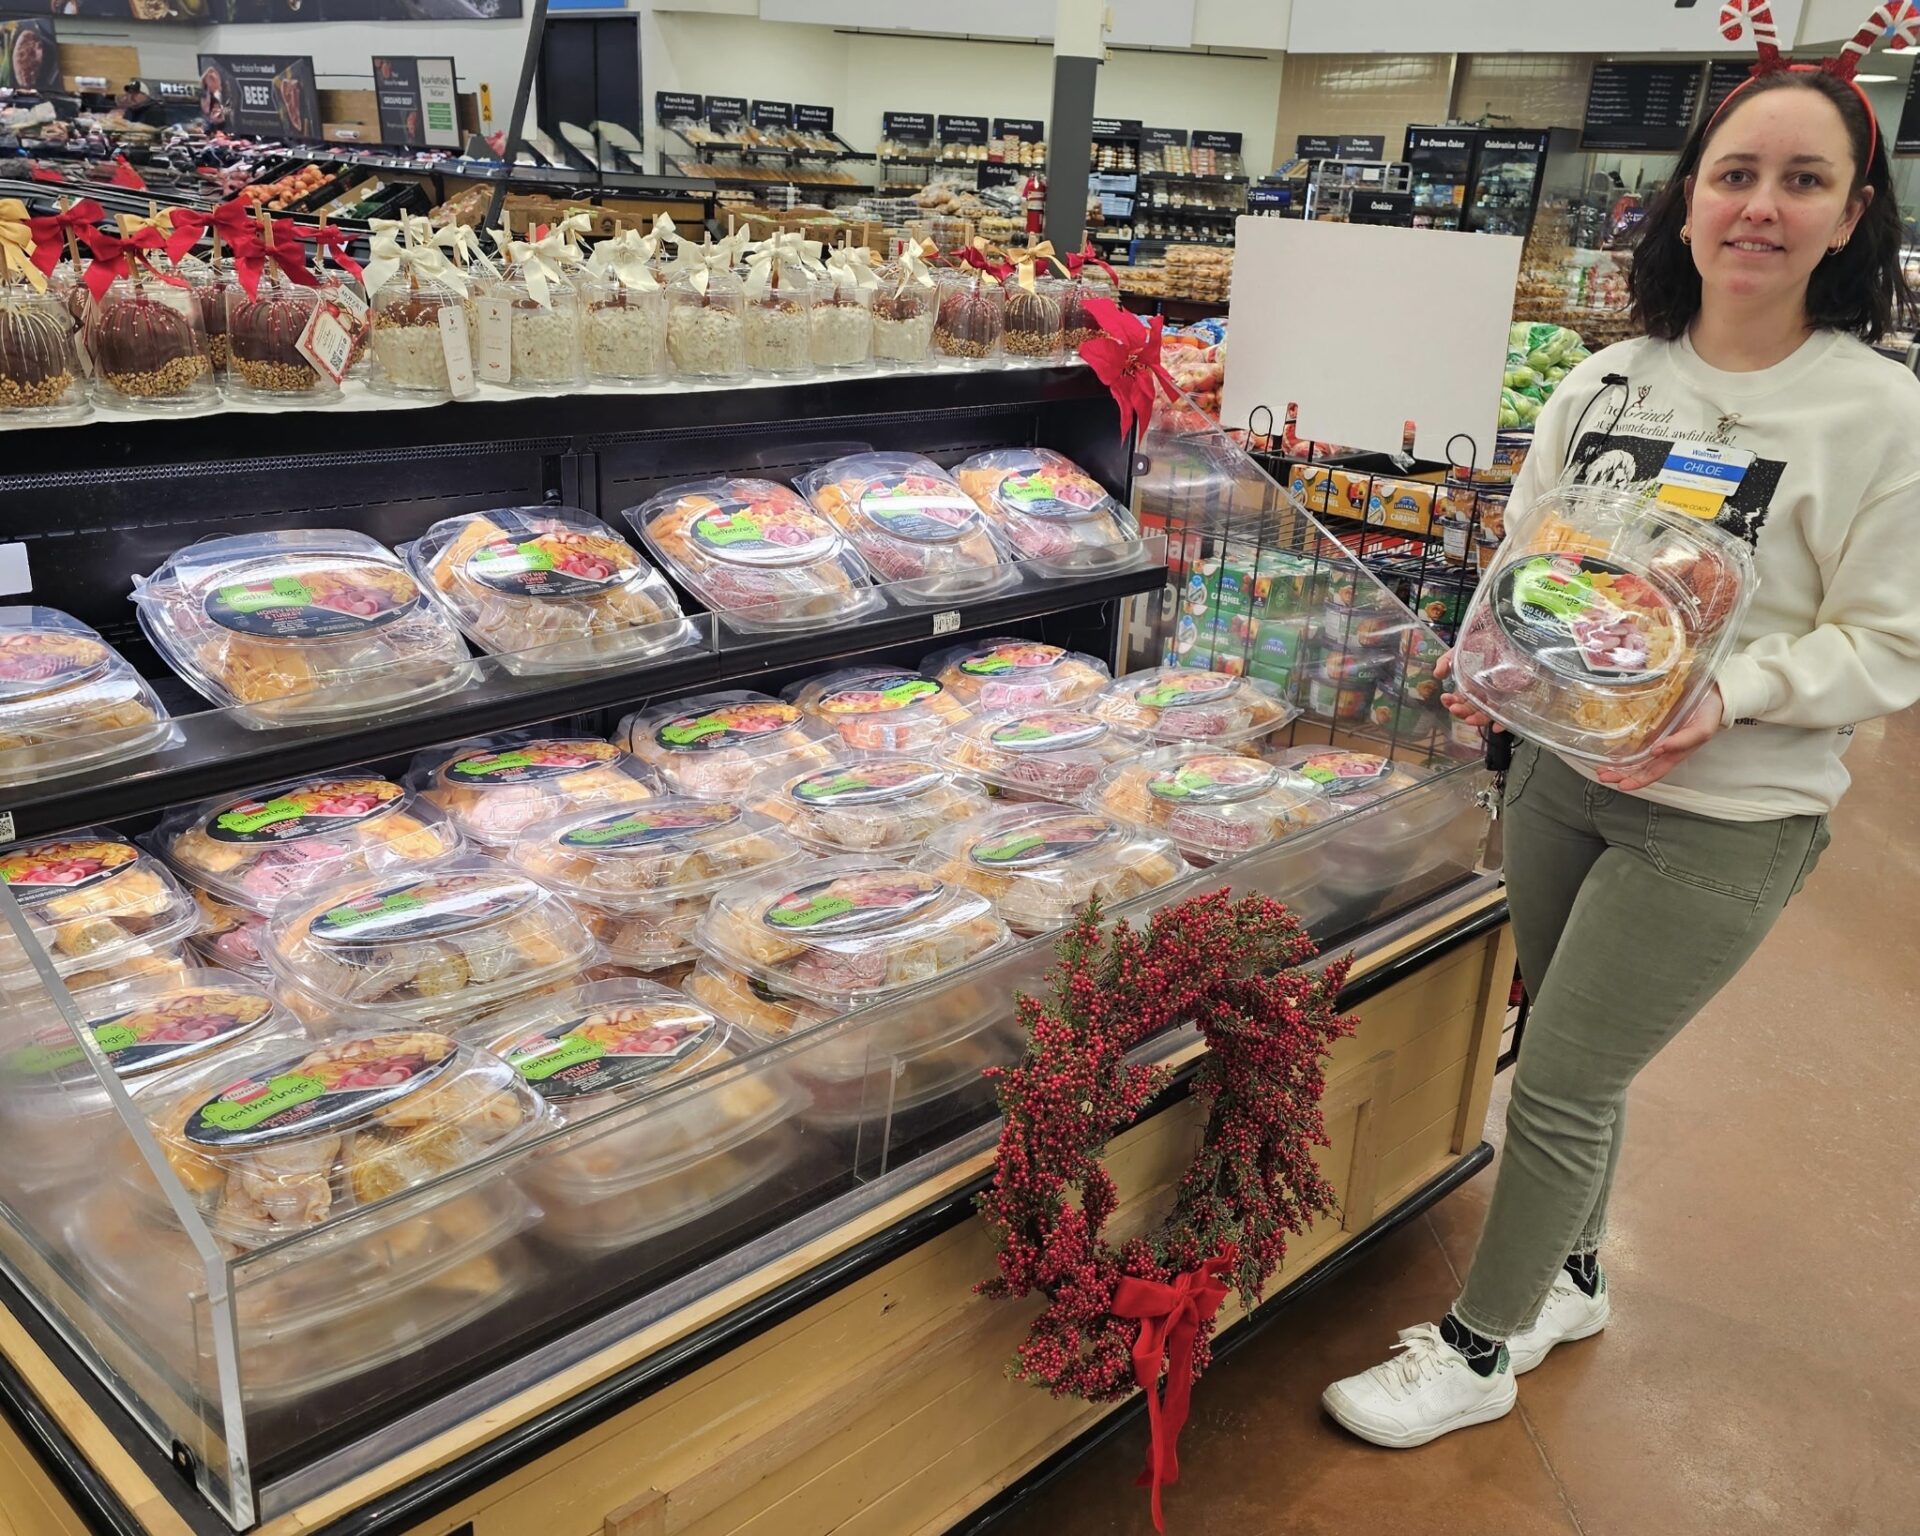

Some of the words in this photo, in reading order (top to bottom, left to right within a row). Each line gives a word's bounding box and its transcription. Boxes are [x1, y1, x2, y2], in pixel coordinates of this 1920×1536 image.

[244, 85, 270, 105] BEEF
[384, 96, 401, 105] GROUND
[402, 97, 412, 105] BEEF
[665, 96, 680, 104] French
[681, 97, 694, 105] Bread
[713, 100, 728, 108] French
[1420, 138, 1429, 148] Ice
[1429, 139, 1447, 148] Cream
[1448, 139, 1465, 148] Cakes
[1485, 140, 1516, 149] Celebration
[1517, 141, 1535, 150] Cakes
[987, 166, 999, 174] Garlic
[1371, 201, 1393, 211] Cookies
[1624, 406, 1674, 424] Grinch
[1671, 429, 1706, 443] awful
[1706, 434, 1737, 447] ida!
[1692, 449, 1722, 460] Walmart
[1684, 461, 1724, 476] CHLOE
[1316, 486, 1338, 496] LITEOUSE
[1312, 495, 1339, 508] CARMEL
[1689, 504, 1710, 513] COACH
[1390, 514, 1420, 526] CARAMEL
[256, 608, 283, 616] HONEY
[284, 606, 304, 614] HAM
[272, 611, 302, 620] TURKEY
[232, 805, 294, 825] Gatherings
[524, 1040, 553, 1054] Hormel
[520, 1046, 592, 1071] Gatherings
[552, 1064, 581, 1080] HONEY
[582, 1058, 601, 1068] HAM
[569, 1064, 601, 1080] TURKEY
[226, 1082, 264, 1100] Hormel
[220, 1081, 309, 1123] Gatherings
